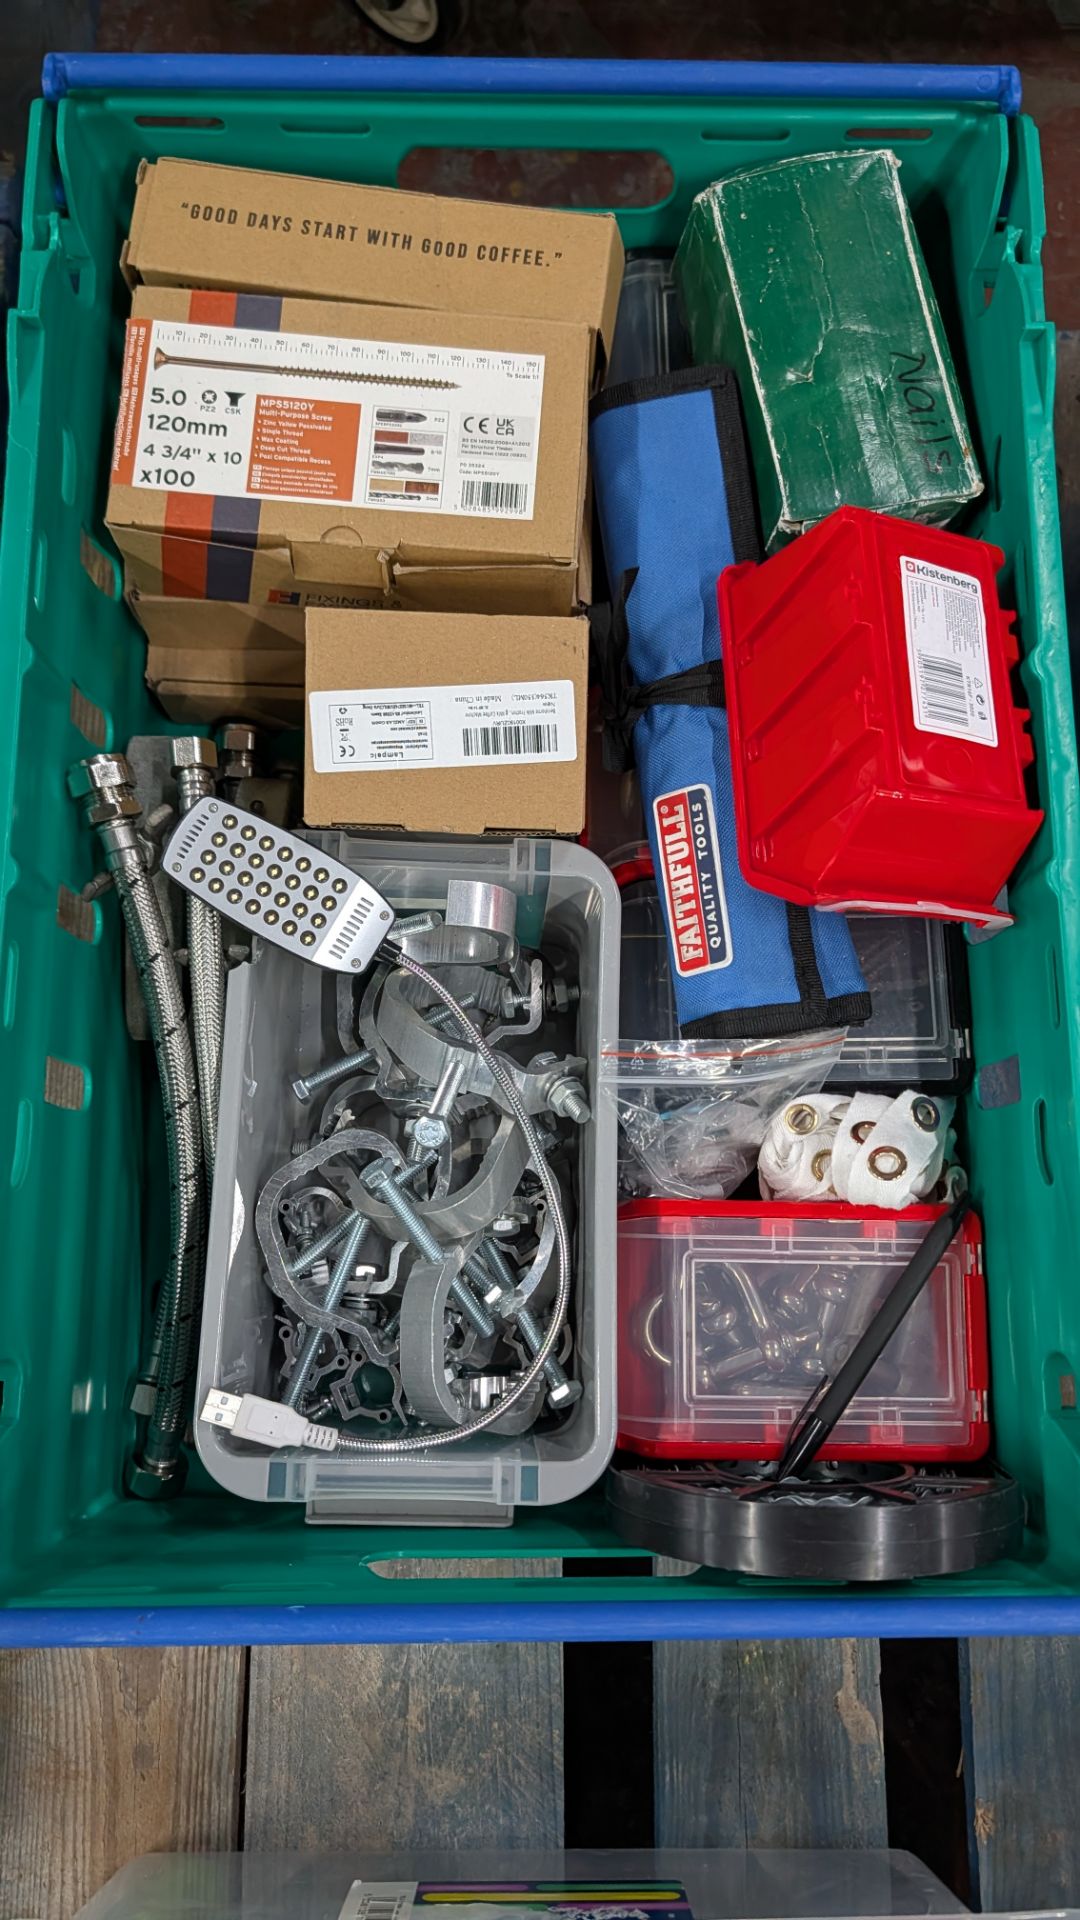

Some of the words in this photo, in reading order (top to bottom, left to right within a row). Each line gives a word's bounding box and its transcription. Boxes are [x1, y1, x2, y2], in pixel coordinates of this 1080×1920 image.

[181, 202, 238, 225] “GOOD
[247, 212, 292, 232] DAYS
[301, 219, 358, 242] START
[367, 228, 412, 250] WITH
[421, 238, 468, 258] GOOD
[477, 245, 562, 267] COFFEE.”
[150, 387, 187, 406] 5.0
[260, 399, 315, 411] MPS5120Y
[200, 405, 216, 413] PZ2
[259, 409, 309, 420] Multi-Purpose
[311, 414, 333, 422] Screw
[889, 352, 953, 473] Nails
[148, 413, 227, 437] 120mm
[463, 416, 490, 434] CE
[496, 418, 515, 427] UK
[496, 427, 515, 436] CA
[143, 444, 155, 456] 4
[161, 445, 201, 460] 3/4"
[207, 452, 216, 463] x
[224, 451, 242, 465] 10
[140, 468, 195, 487] x100
[917, 564, 978, 594] Kistenberg
[339, 745, 355, 757] CE
[691, 803, 708, 860] TOOLS
[662, 804, 704, 962] FAITHFULL
[701, 872, 721, 948] QUALITY
